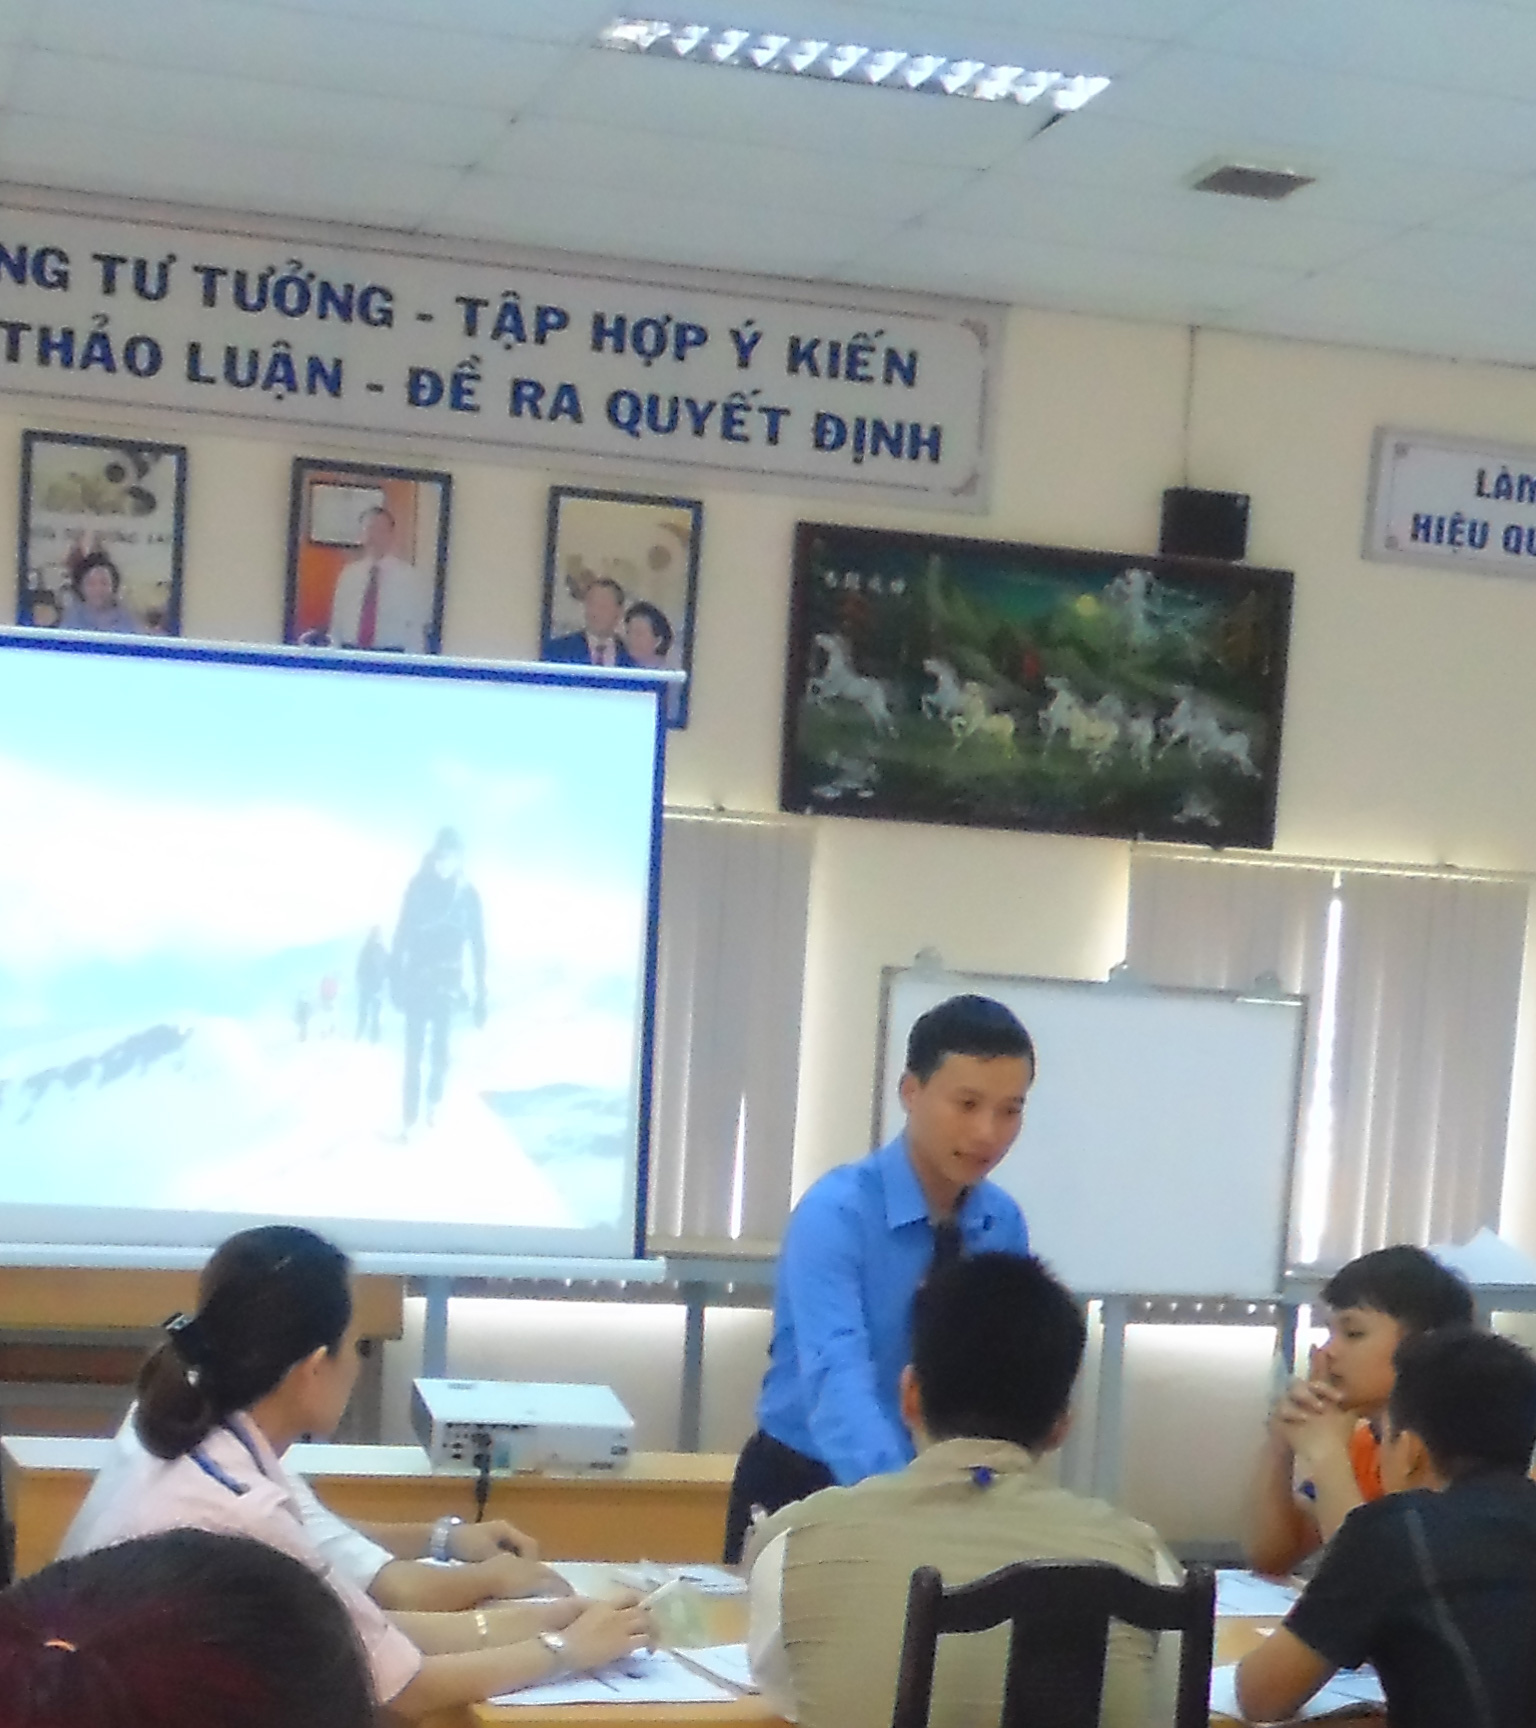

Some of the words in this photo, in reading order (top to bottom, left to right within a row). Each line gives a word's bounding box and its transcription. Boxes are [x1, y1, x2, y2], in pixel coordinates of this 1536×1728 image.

[92, 252, 178, 301] TƯ
[193, 258, 395, 328] TƯỞNG
[455, 290, 571, 351] TẬP
[590, 311, 709, 367] HỢP
[729, 319, 764, 369] Ý
[786, 328, 919, 388] KIẾN
[186, 340, 344, 400] LUẬN
[405, 353, 482, 414] ĐỀ
[508, 376, 584, 425] RA
[606, 386, 792, 446] QUYẾT
[811, 409, 944, 465] ĐỊNH
[1410, 511, 1490, 554] HIỆU
